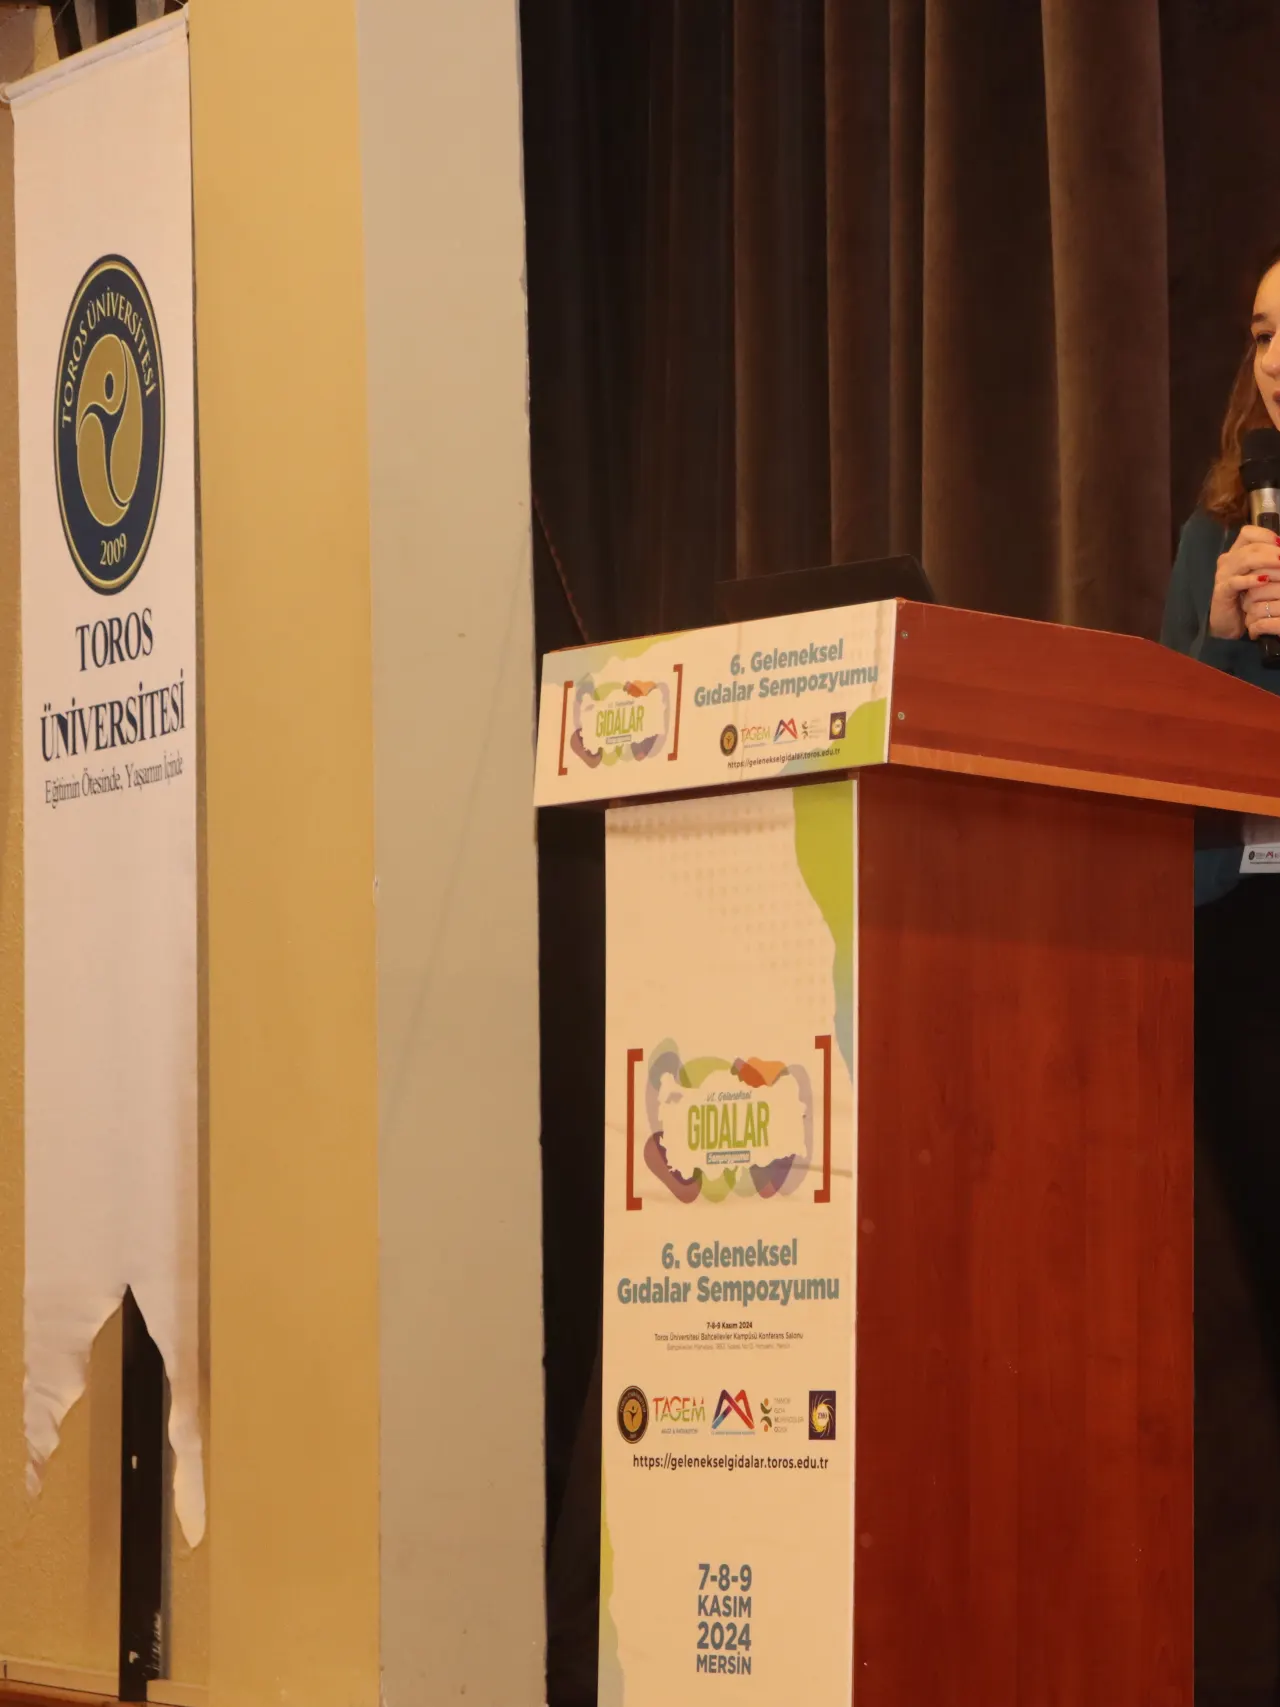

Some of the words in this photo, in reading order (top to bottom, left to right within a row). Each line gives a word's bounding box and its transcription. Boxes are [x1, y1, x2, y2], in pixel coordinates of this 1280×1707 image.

[62, 320, 87, 428] TOROS
[100, 533, 126, 565] 2009
[75, 607, 153, 672] TOROS
[730, 654, 745, 676] 6.
[750, 638, 843, 672] Geleneksel
[694, 681, 754, 707] Gıdalar
[758, 666, 879, 698] Sempozyumu
[40, 668, 185, 762] ÜNİVERSİTESİ
[596, 705, 644, 737] GIDALAR
[81, 766, 123, 796] Ötesinde,
[688, 1101, 769, 1151] GIDALAR
[661, 1243, 680, 1269] 6.
[686, 1238, 797, 1268] Geleneksel
[617, 1276, 691, 1304] Gıdalar
[696, 1276, 839, 1307] Sempozyumu
[652, 1396, 706, 1422] TAGEM
[633, 1453, 829, 1471] https://gelenekselgidalar.toros.edu.tr
[698, 1563, 752, 1592] 7-8-9
[698, 1595, 752, 1618] KASIM
[697, 1621, 752, 1651] 2024
[696, 1651, 752, 1675] MERSİN
